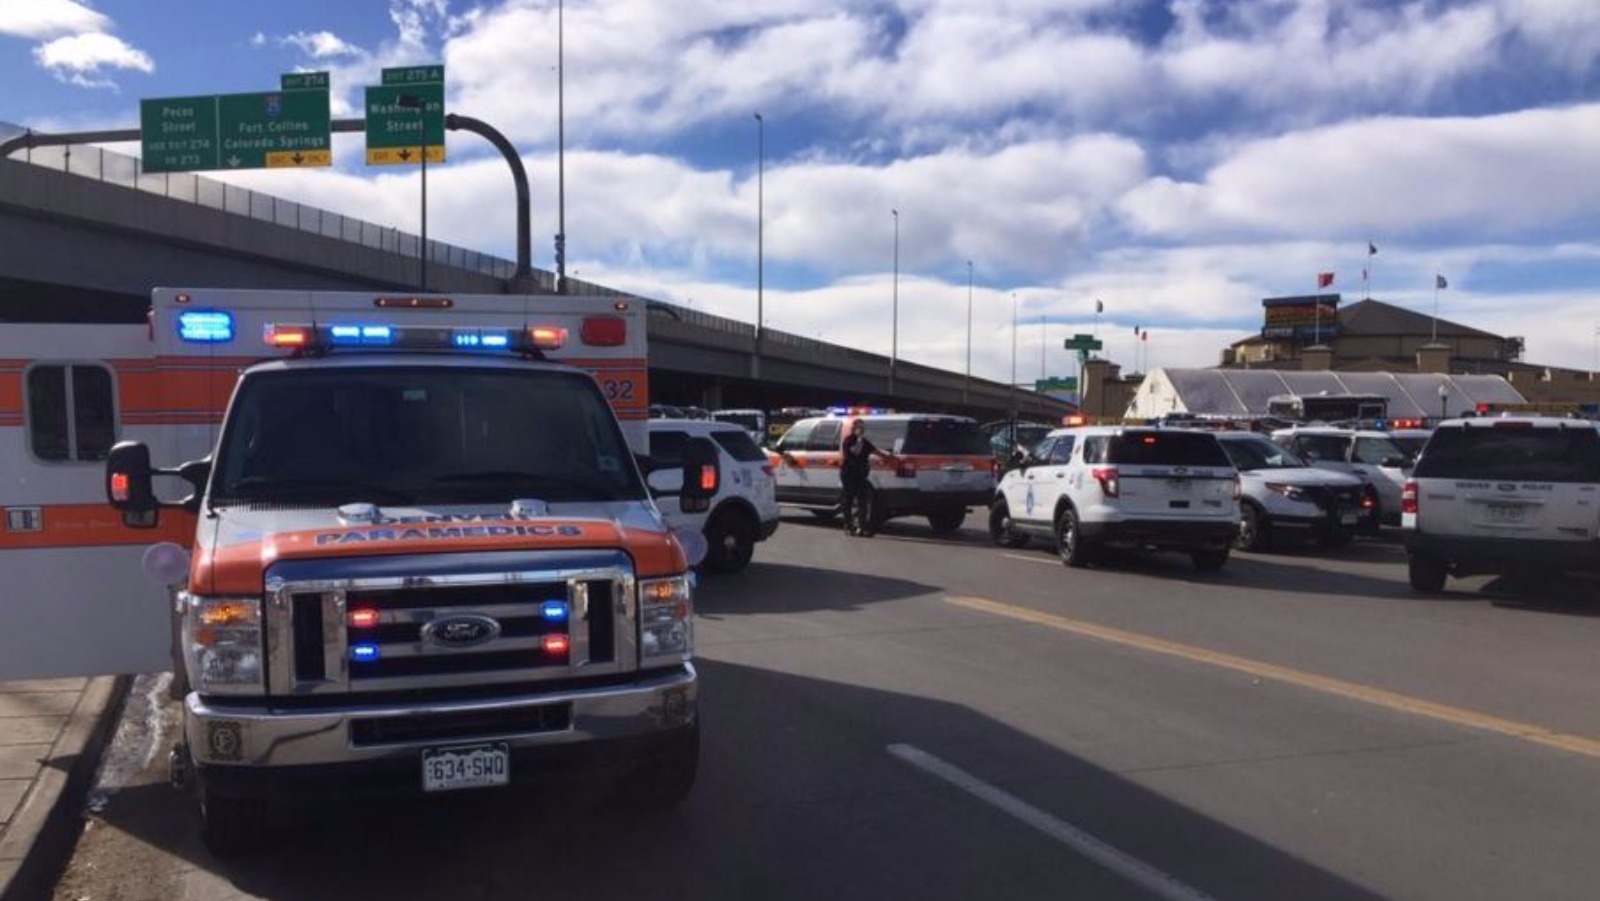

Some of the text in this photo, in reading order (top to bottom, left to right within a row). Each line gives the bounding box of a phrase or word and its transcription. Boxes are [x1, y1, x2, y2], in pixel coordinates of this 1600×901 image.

[431, 69, 440, 79] A
[371, 94, 440, 116] Washngon
[162, 107, 194, 118] Pecos
[162, 121, 196, 133] Street
[240, 120, 309, 133] Fort Collins
[387, 119, 424, 132] Street
[224, 136, 324, 149] Colorado Springs
[604, 379, 634, 400] 32
[315, 526, 582, 546] PARAMEDICS
